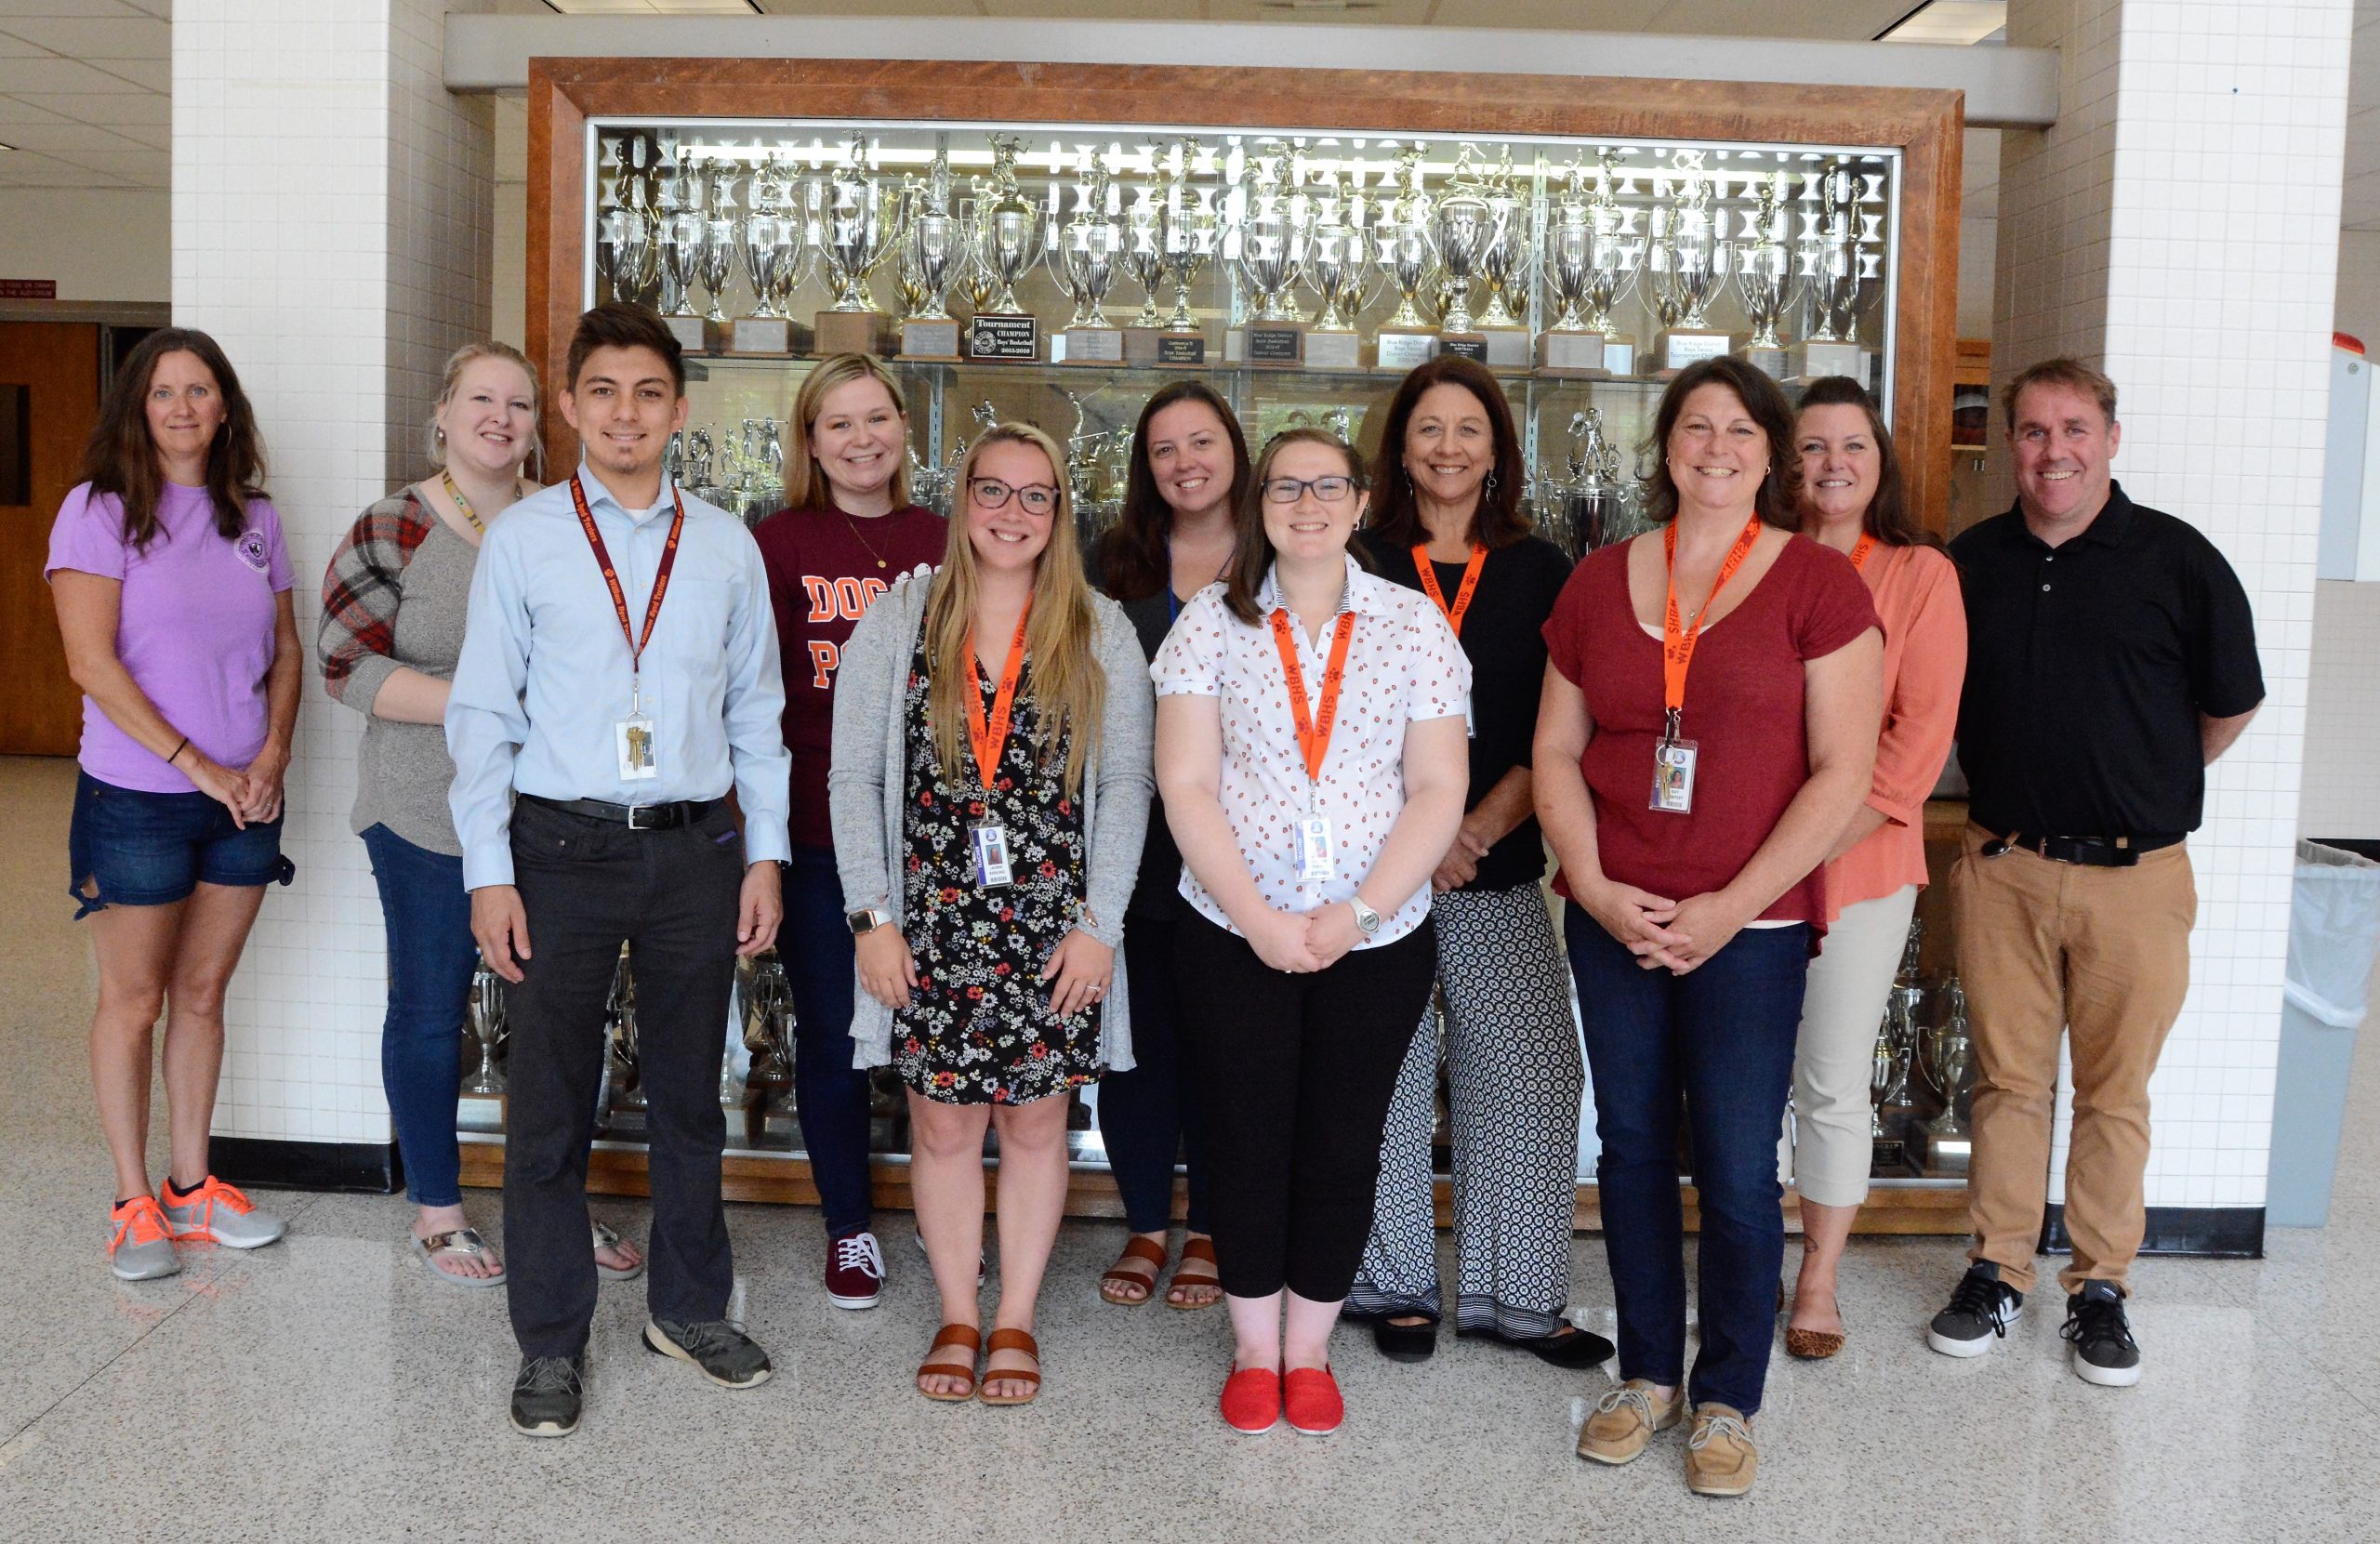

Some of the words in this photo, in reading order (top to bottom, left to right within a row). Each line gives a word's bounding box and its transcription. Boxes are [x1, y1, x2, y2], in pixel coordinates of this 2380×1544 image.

[976, 319, 1030, 329] Tournament
[1851, 543, 1869, 565] BHS
[653, 574, 668, 600] Terriers
[1421, 567, 1439, 598] WBHS
[609, 578, 622, 604] William
[617, 605, 628, 623] Byrd
[649, 601, 659, 618] Byrd
[1668, 599, 1680, 634] WBHS
[641, 618, 654, 643] William
[1675, 625, 1698, 665] WBHS
[808, 640, 849, 689] P
[1287, 664, 1304, 705] WBHS
[990, 706, 1007, 749] WBHS
[1317, 695, 1335, 737] WBHS
[974, 846, 983, 868] TEACHER
